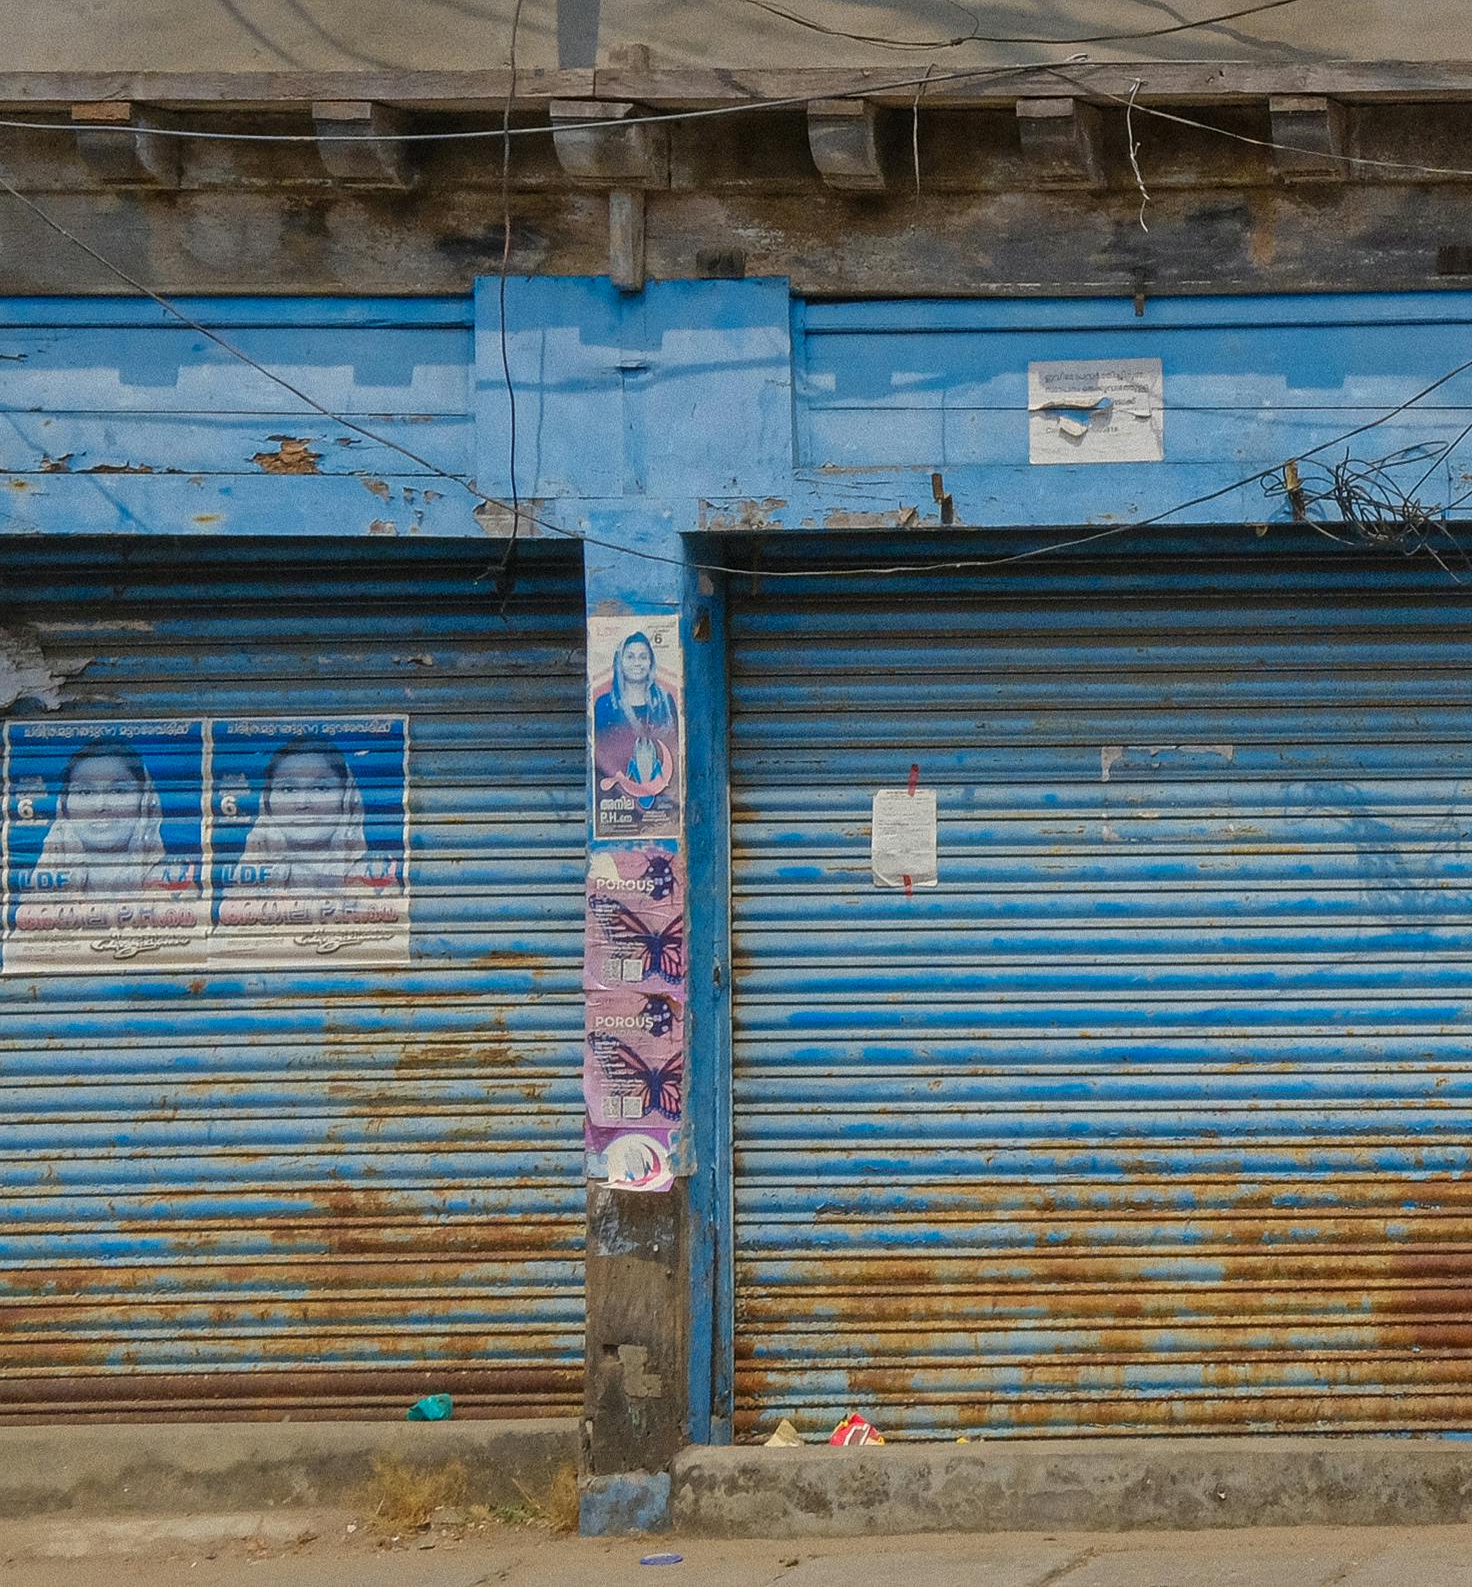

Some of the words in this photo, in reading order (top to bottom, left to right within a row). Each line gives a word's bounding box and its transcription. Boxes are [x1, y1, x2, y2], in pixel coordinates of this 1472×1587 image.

[18, 798, 34, 819] 6
[221, 796, 237, 816] 6
[18, 870, 70, 890] LDF
[221, 865, 273, 885] LDF
[596, 878, 655, 891] POROUS
[595, 1016, 654, 1031] POROUS
